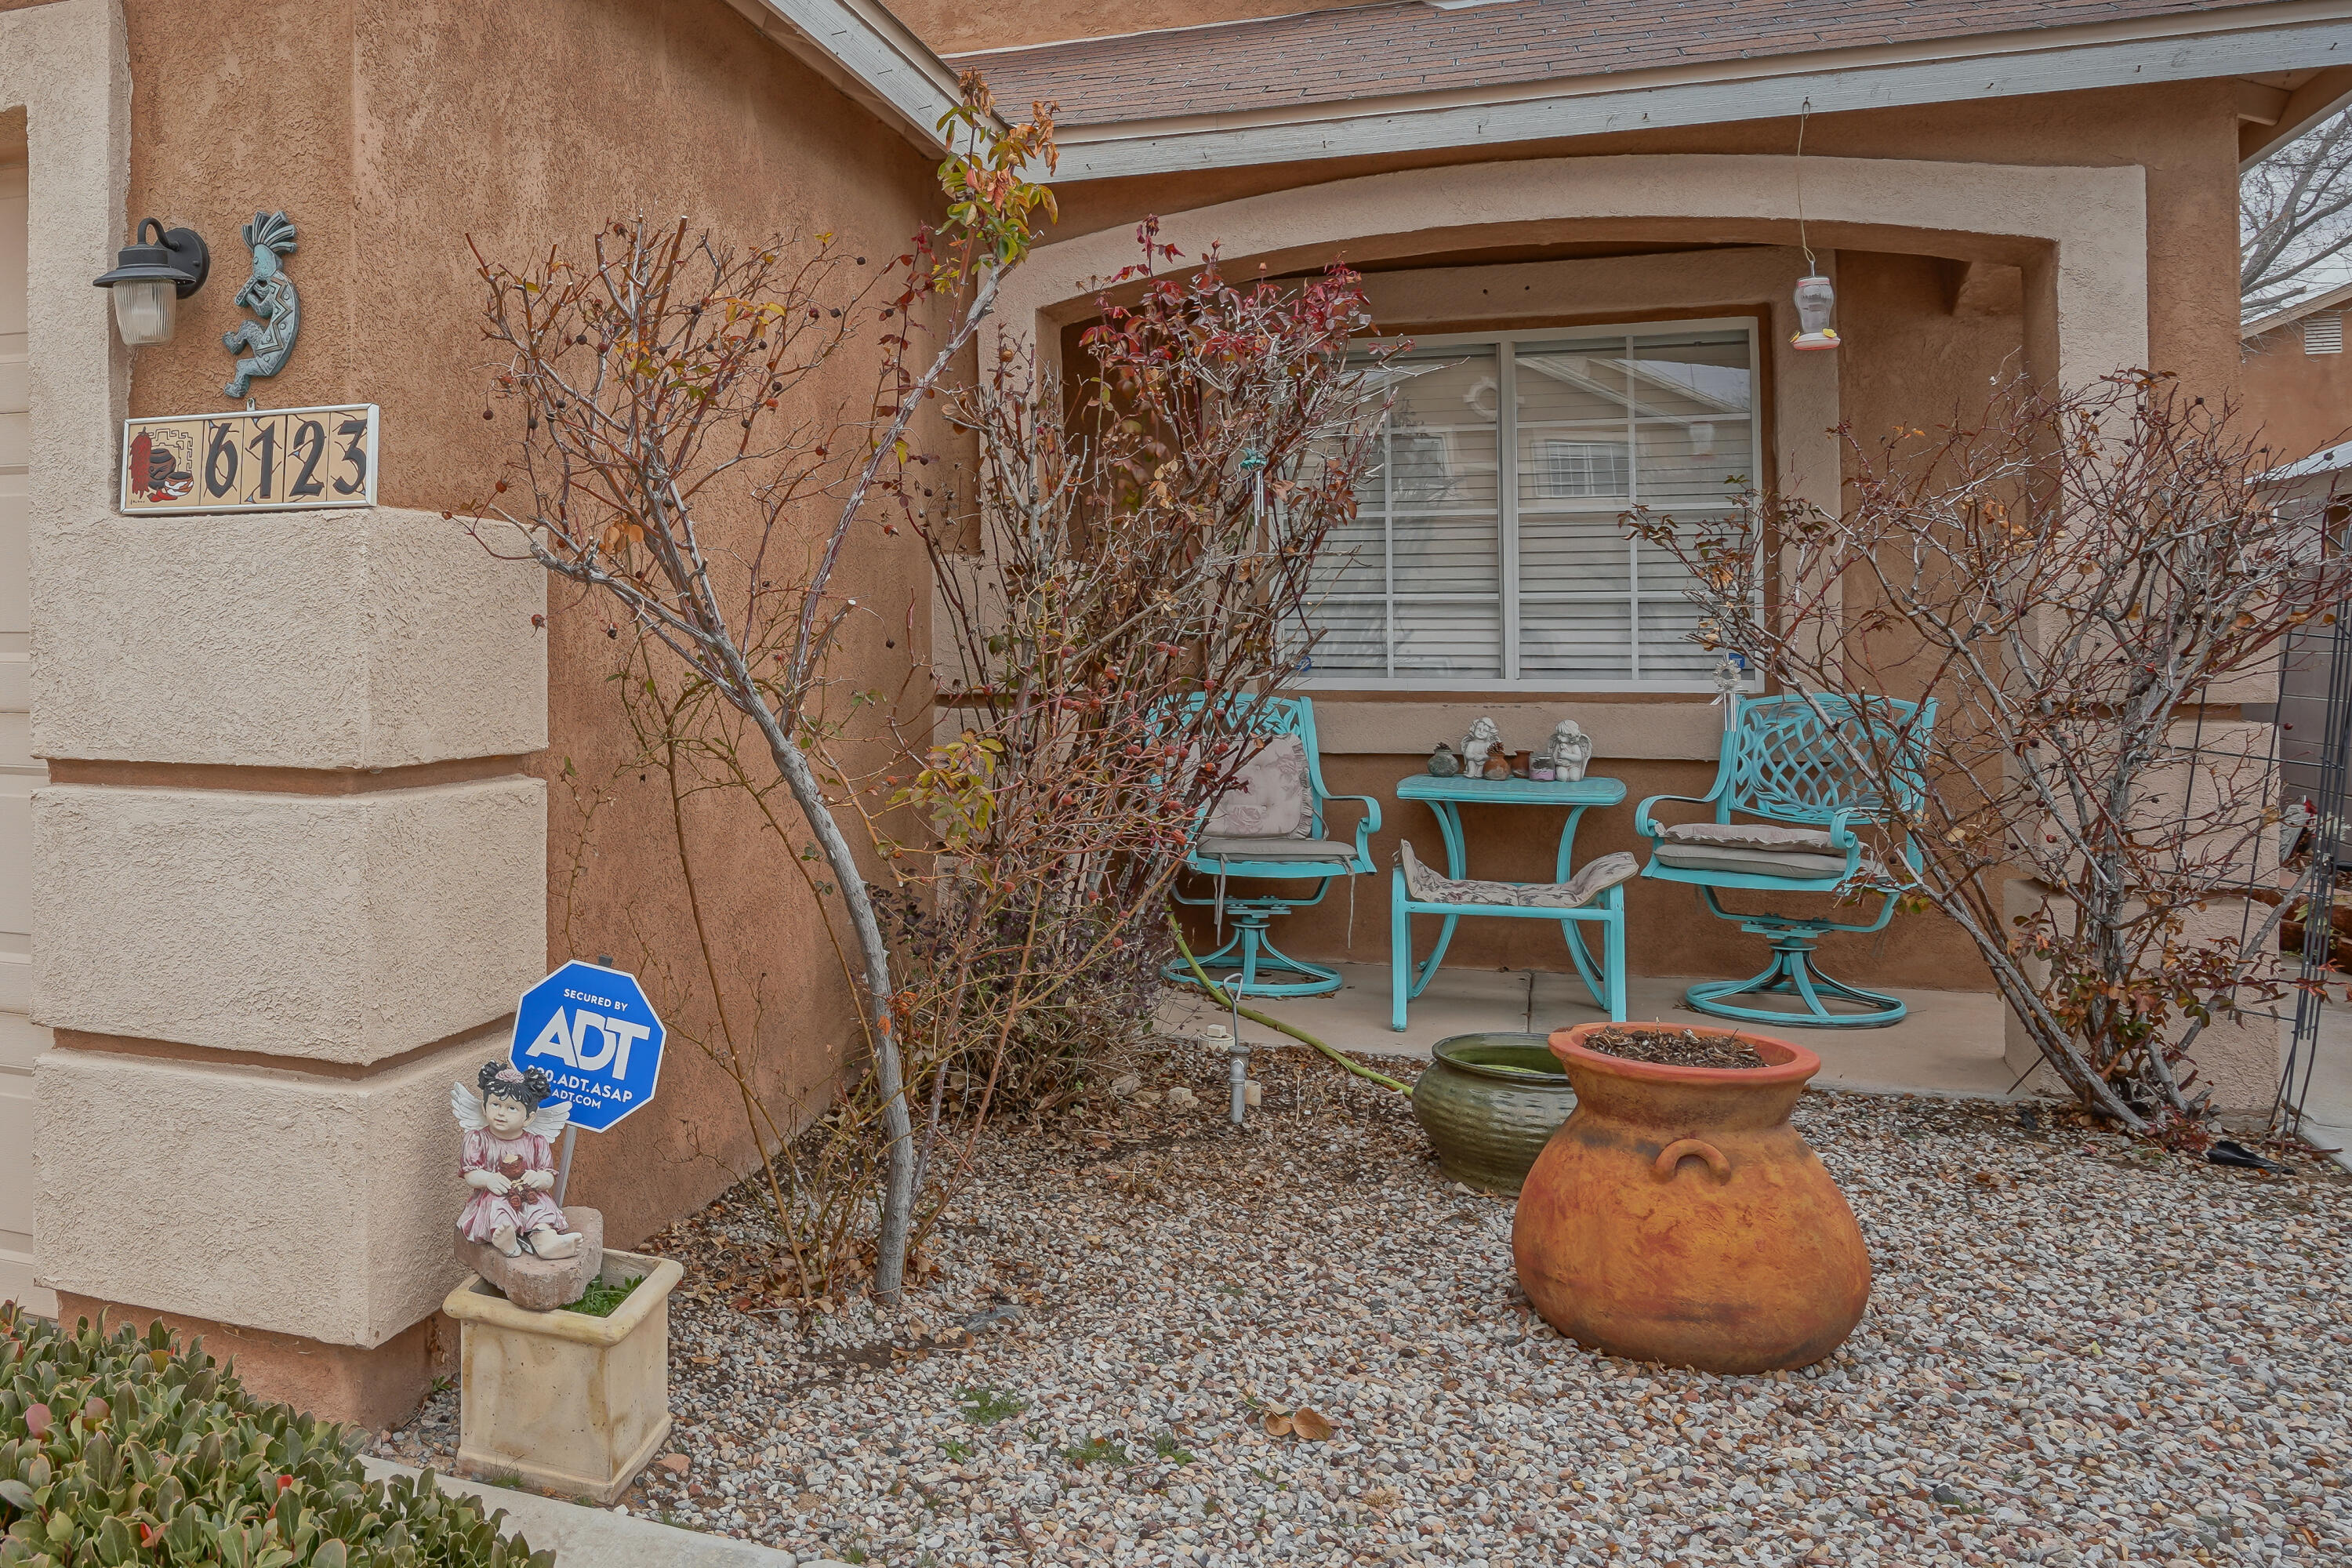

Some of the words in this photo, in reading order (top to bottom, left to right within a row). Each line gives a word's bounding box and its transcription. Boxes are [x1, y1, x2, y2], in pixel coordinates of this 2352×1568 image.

[205, 419, 368, 499] 6123
[563, 988, 612, 1008] SECURED
[614, 1002, 629, 1012] BY
[524, 1004, 651, 1081] ADT
[528, 1065, 633, 1103] 0.ADT.ASAP
[551, 1088, 602, 1109] ADT.COM
